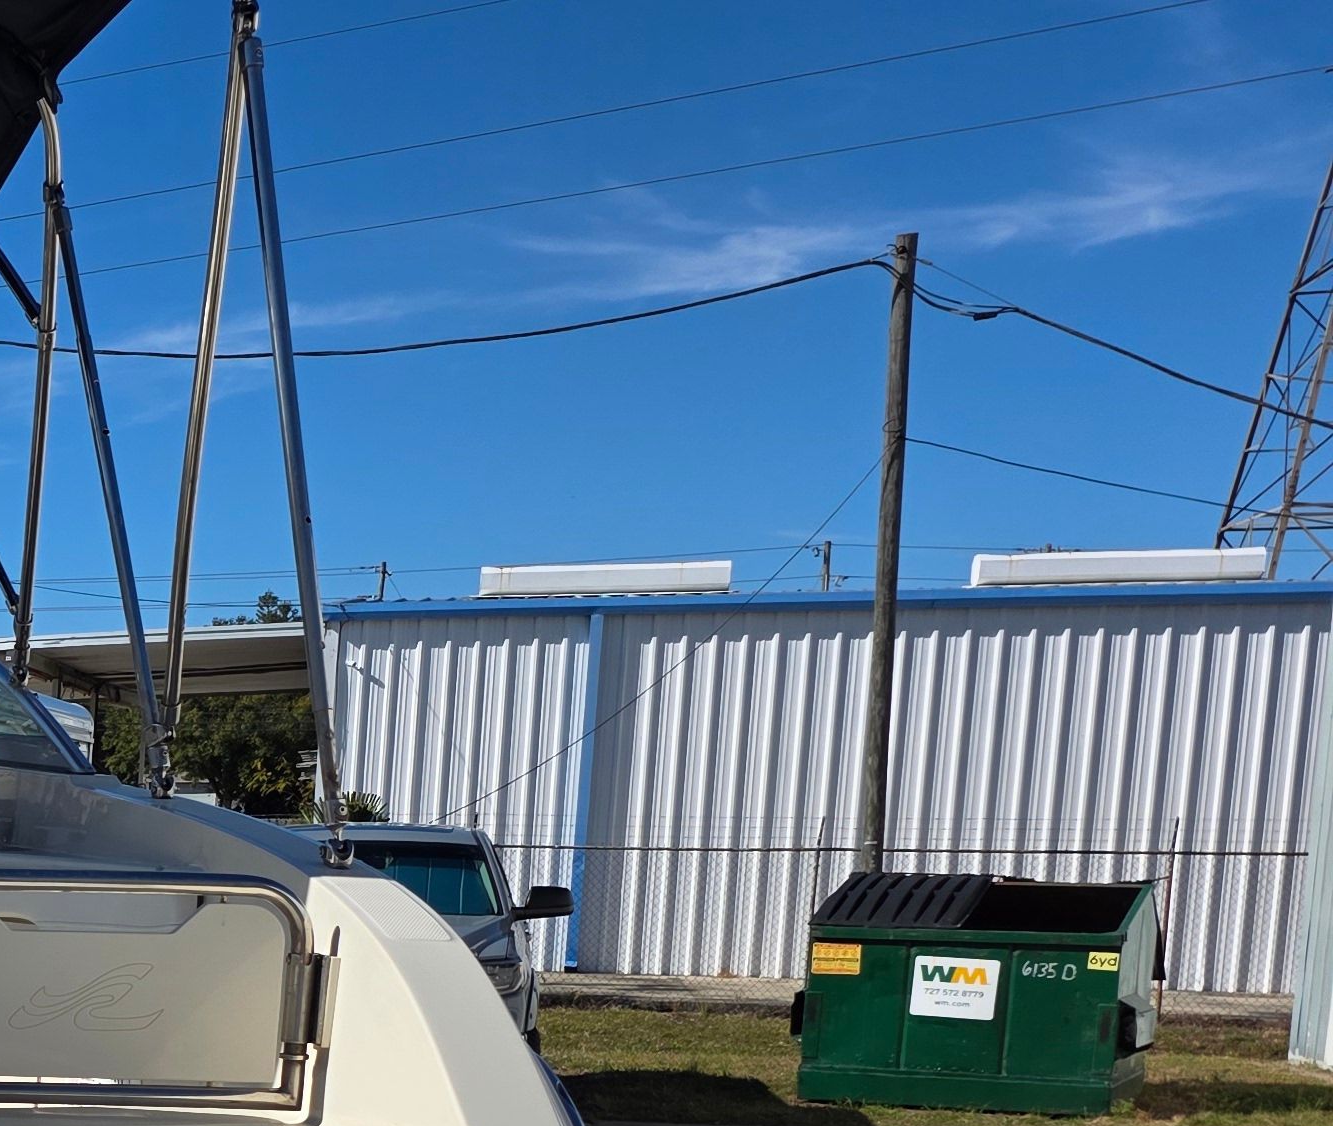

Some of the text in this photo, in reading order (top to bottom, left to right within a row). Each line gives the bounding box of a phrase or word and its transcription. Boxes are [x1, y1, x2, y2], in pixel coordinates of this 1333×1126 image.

[1021, 960, 1059, 979] 6135
[1089, 955, 1118, 968] 6yd
[921, 965, 988, 985] WM
